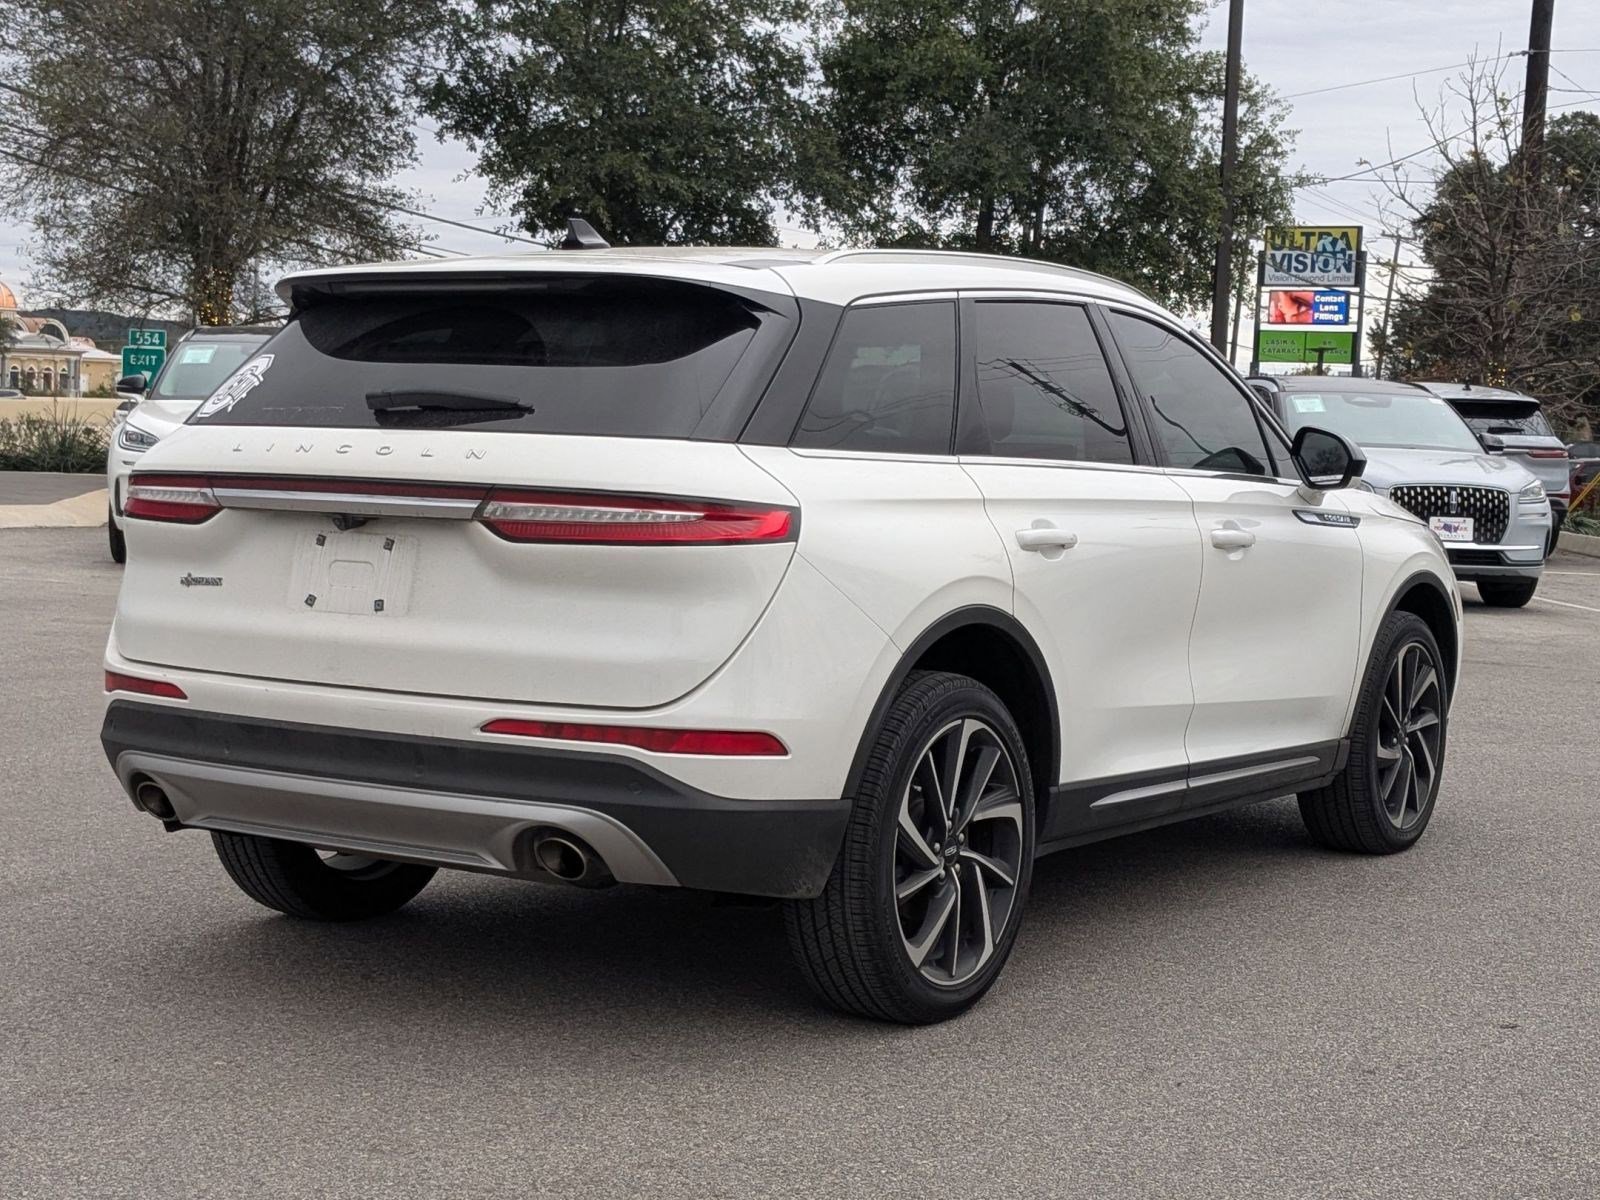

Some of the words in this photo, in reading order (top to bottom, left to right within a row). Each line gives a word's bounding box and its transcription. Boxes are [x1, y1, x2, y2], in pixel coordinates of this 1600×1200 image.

[1270, 232, 1353, 250] ULTRA
[1270, 253, 1353, 273] VISION
[1268, 273, 1291, 282] Vision
[1327, 274, 1351, 282] Limits
[1314, 295, 1345, 303] Contact
[1319, 303, 1339, 312] Lens
[1314, 312, 1344, 322] Fittings
[135, 332, 160, 345] 554
[130, 354, 158, 365] EXIT
[231, 442, 488, 461] LINCOLN
